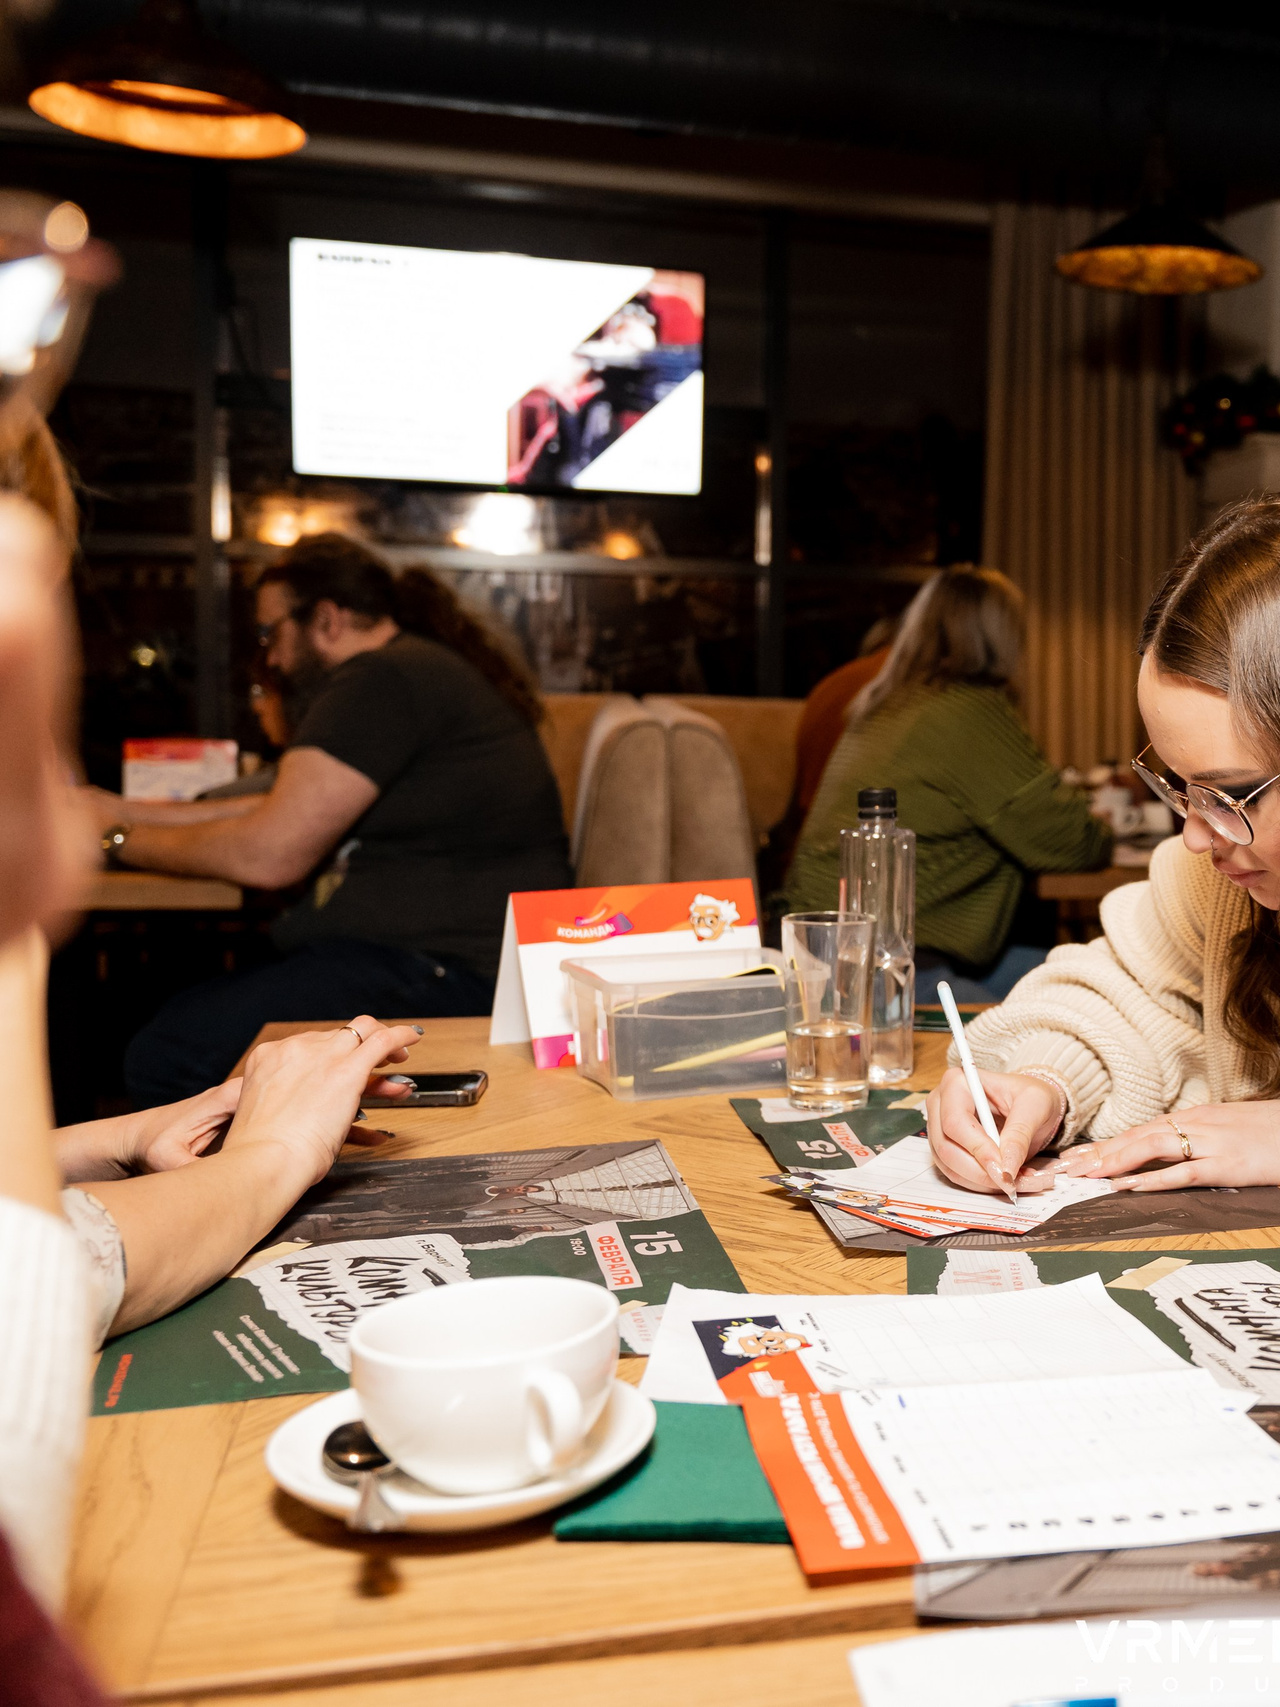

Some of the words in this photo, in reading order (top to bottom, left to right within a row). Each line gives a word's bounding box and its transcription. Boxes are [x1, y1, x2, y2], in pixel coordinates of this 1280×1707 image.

[796, 1139, 843, 1160] 15
[569, 1237, 587, 1256] 19:00
[629, 1231, 684, 1256] 15
[596, 1235, 635, 1286] ФЕВРАЛЯ
[345, 1256, 424, 1308] КОМН
